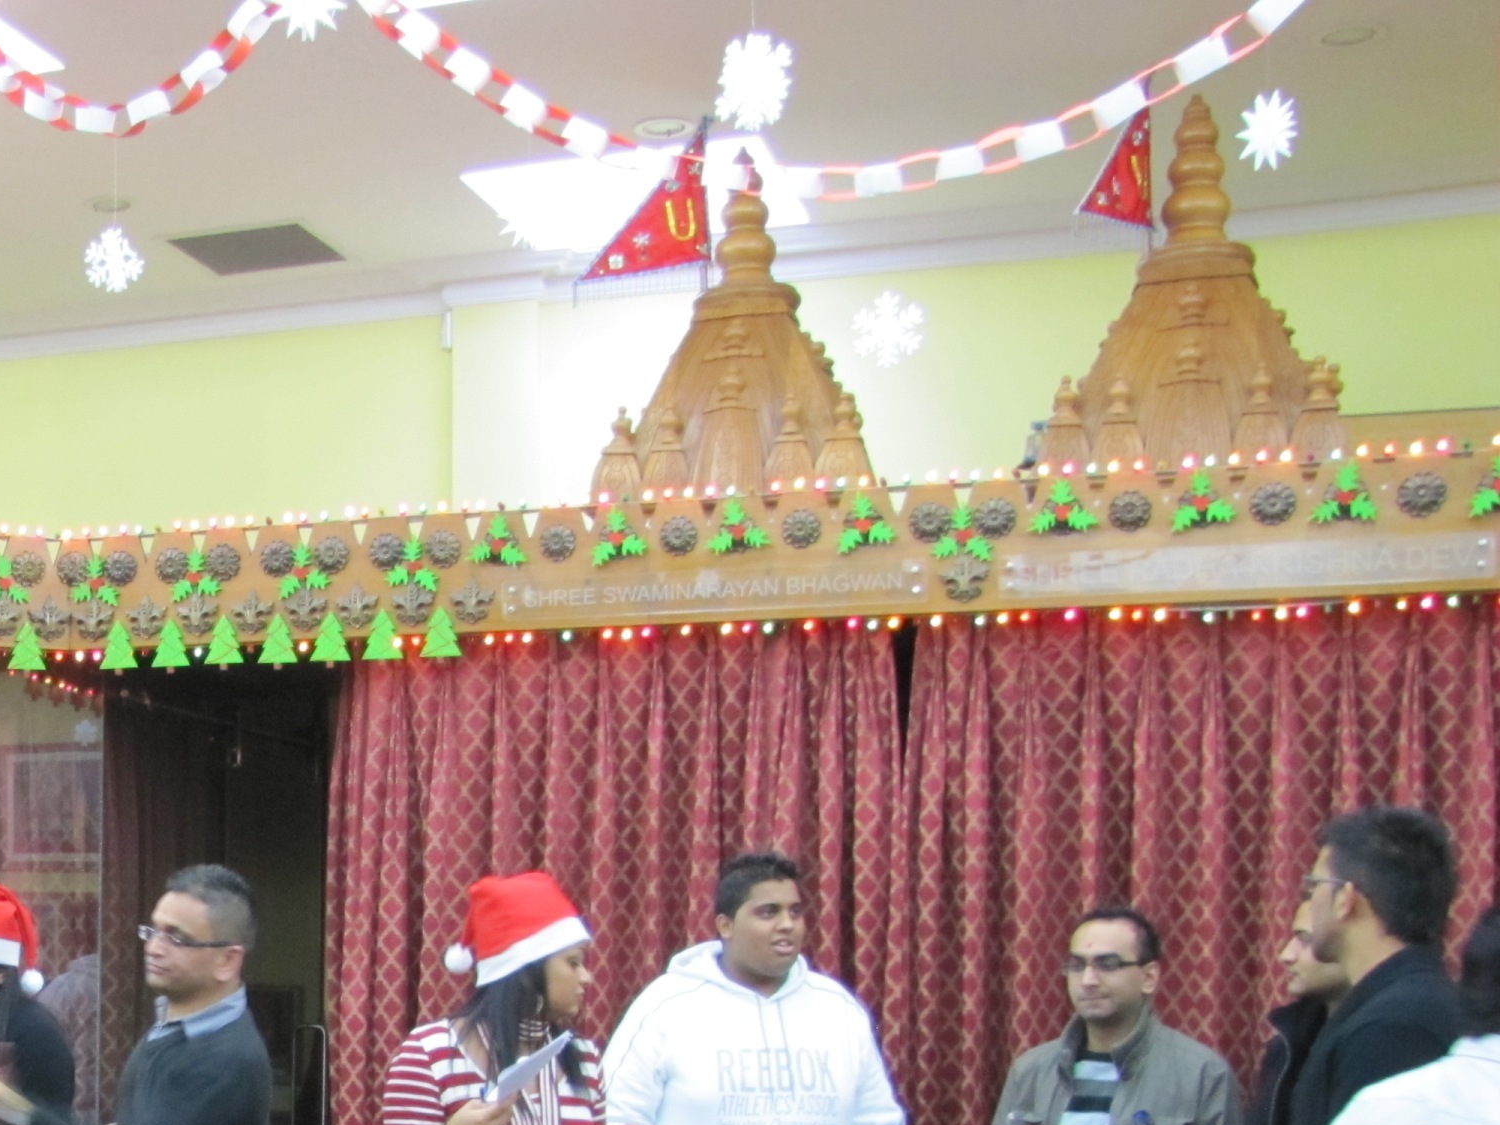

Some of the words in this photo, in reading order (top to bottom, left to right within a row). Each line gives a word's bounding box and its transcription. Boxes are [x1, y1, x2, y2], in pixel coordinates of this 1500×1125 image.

[1405, 545, 1476, 569] DEV
[524, 588, 595, 609] SHREE
[603, 577, 779, 604] SWAMINARAYAN
[786, 573, 903, 596] BHAGWAN
[716, 1047, 838, 1093] REEBOK
[717, 1094, 792, 1117] ATHLETICS
